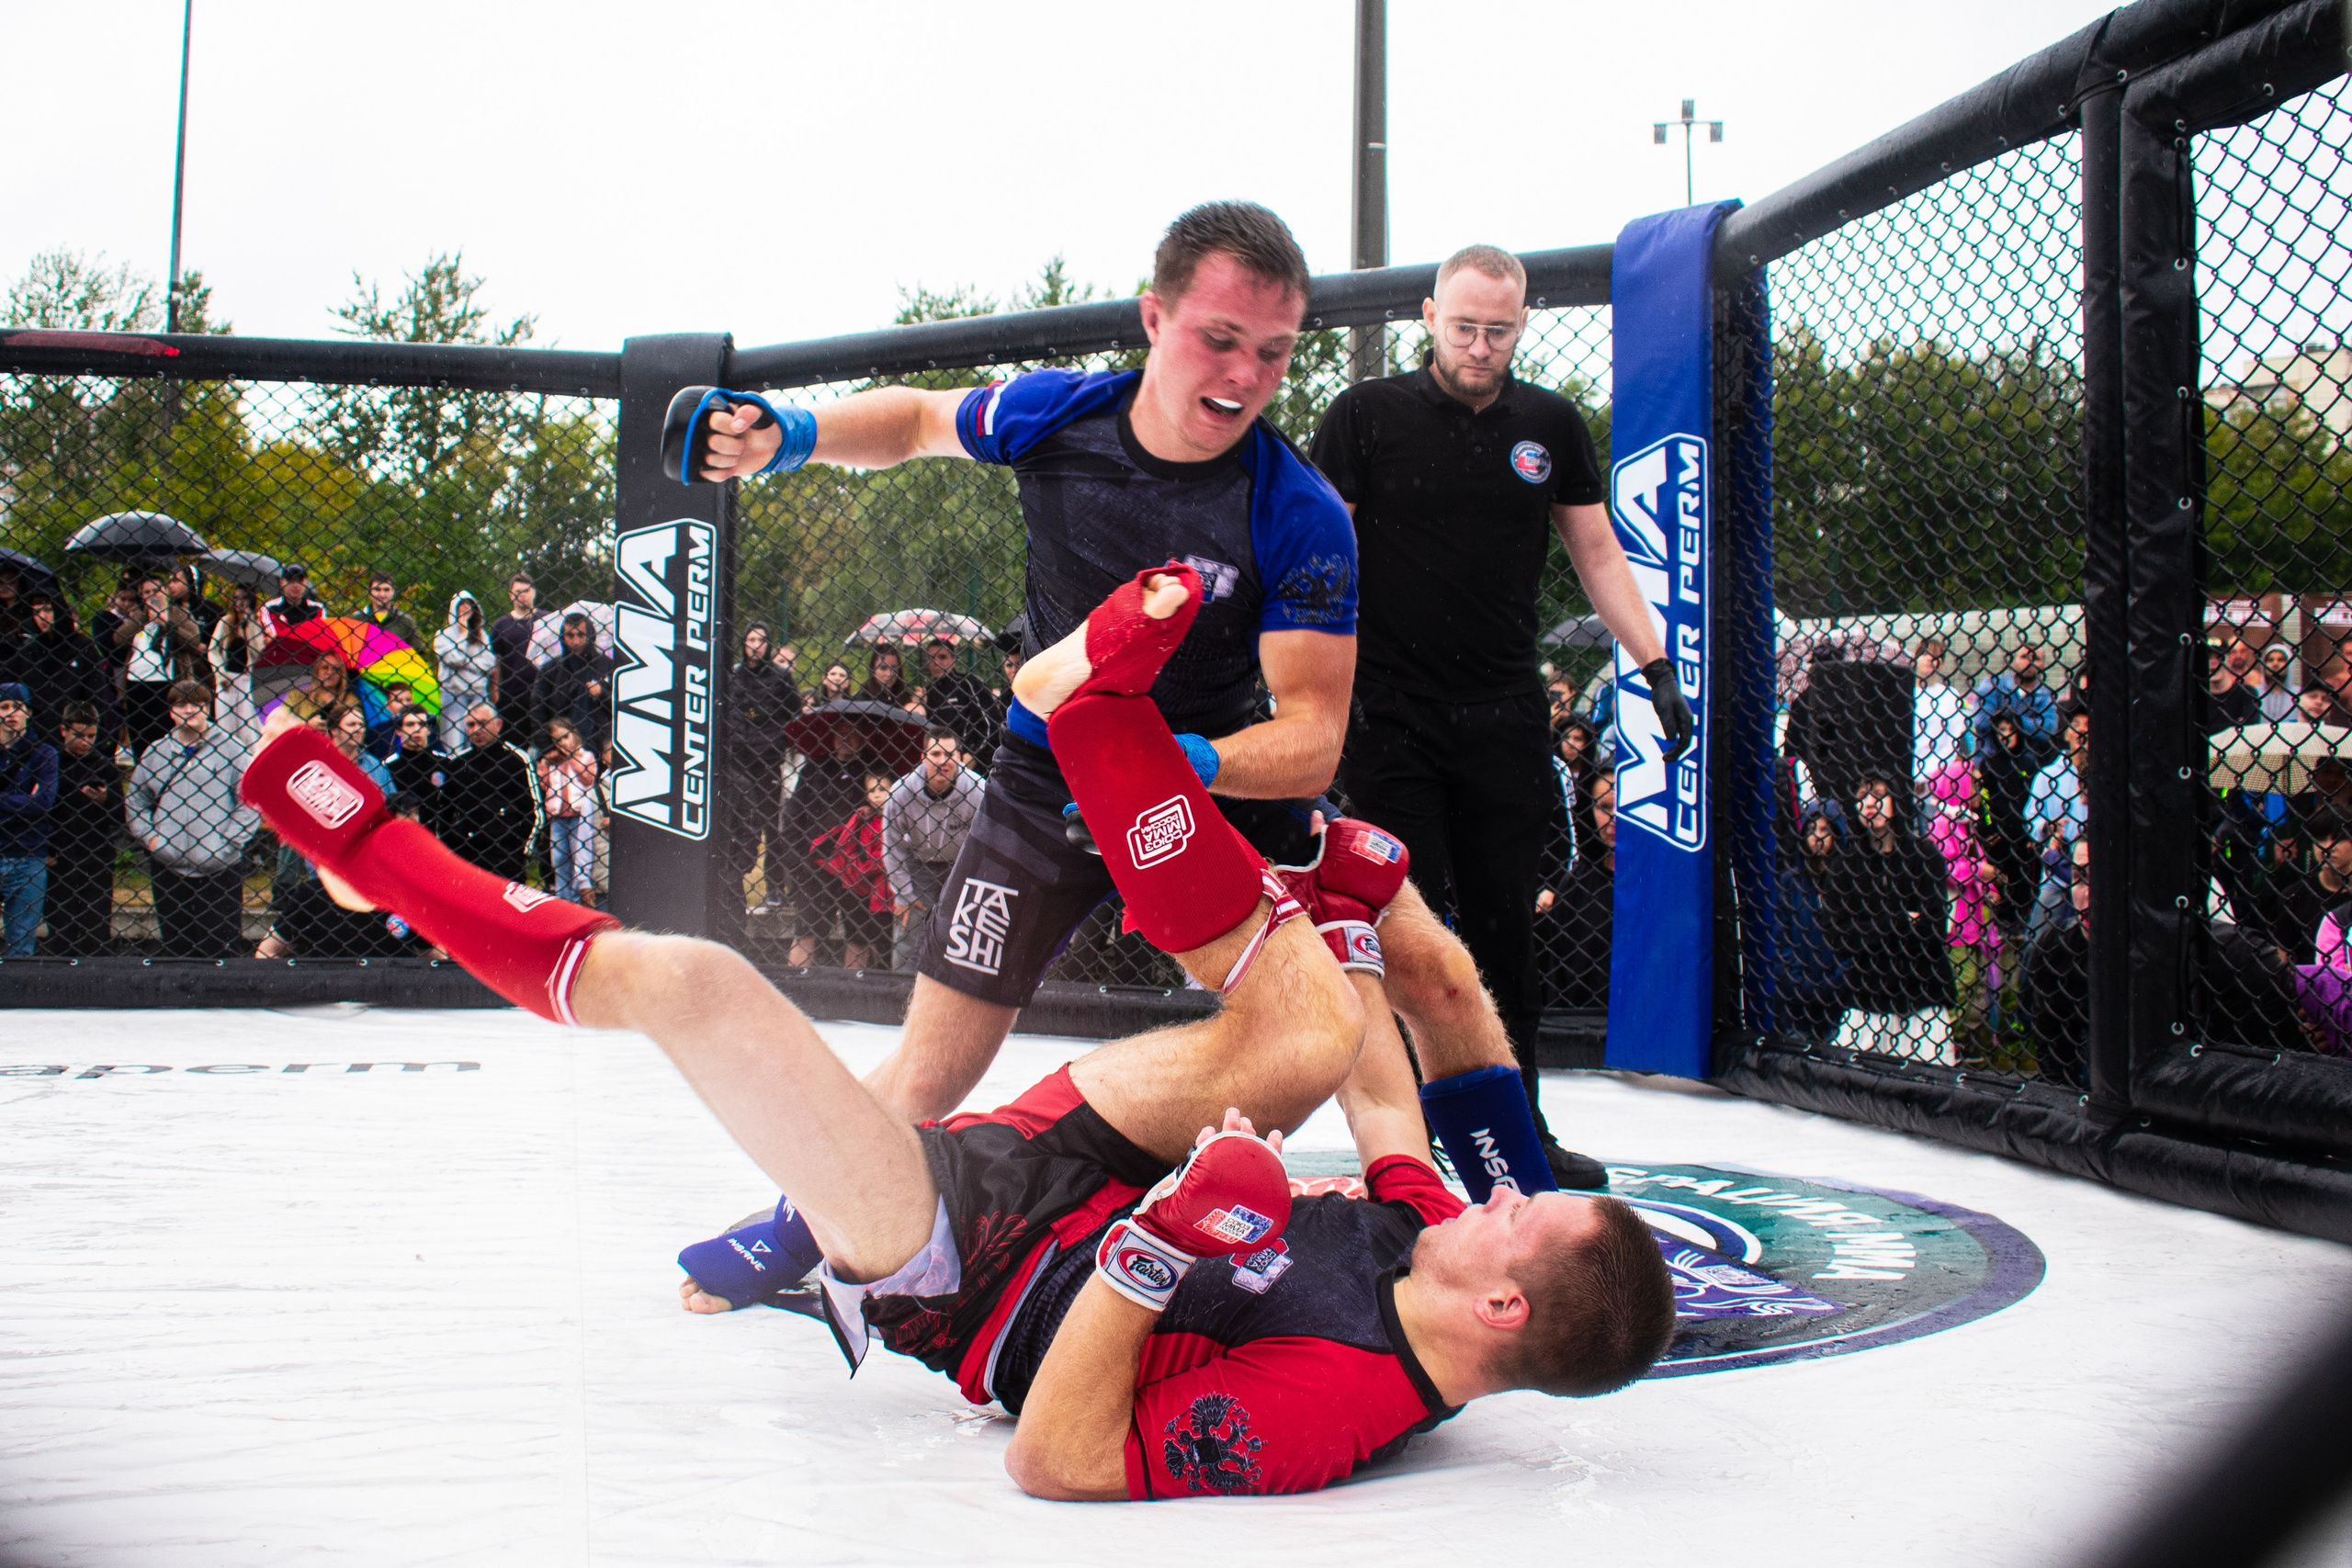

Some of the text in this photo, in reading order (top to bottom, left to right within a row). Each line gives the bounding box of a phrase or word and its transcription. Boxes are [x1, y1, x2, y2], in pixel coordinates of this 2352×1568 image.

[616, 526, 676, 824] MMA
[683, 525, 709, 833] CENTER PERM
[1676, 442, 1700, 843] CENER PERM
[1141, 813, 1179, 834] РОССИИ
[1145, 829, 1182, 852] СОЮЗ
